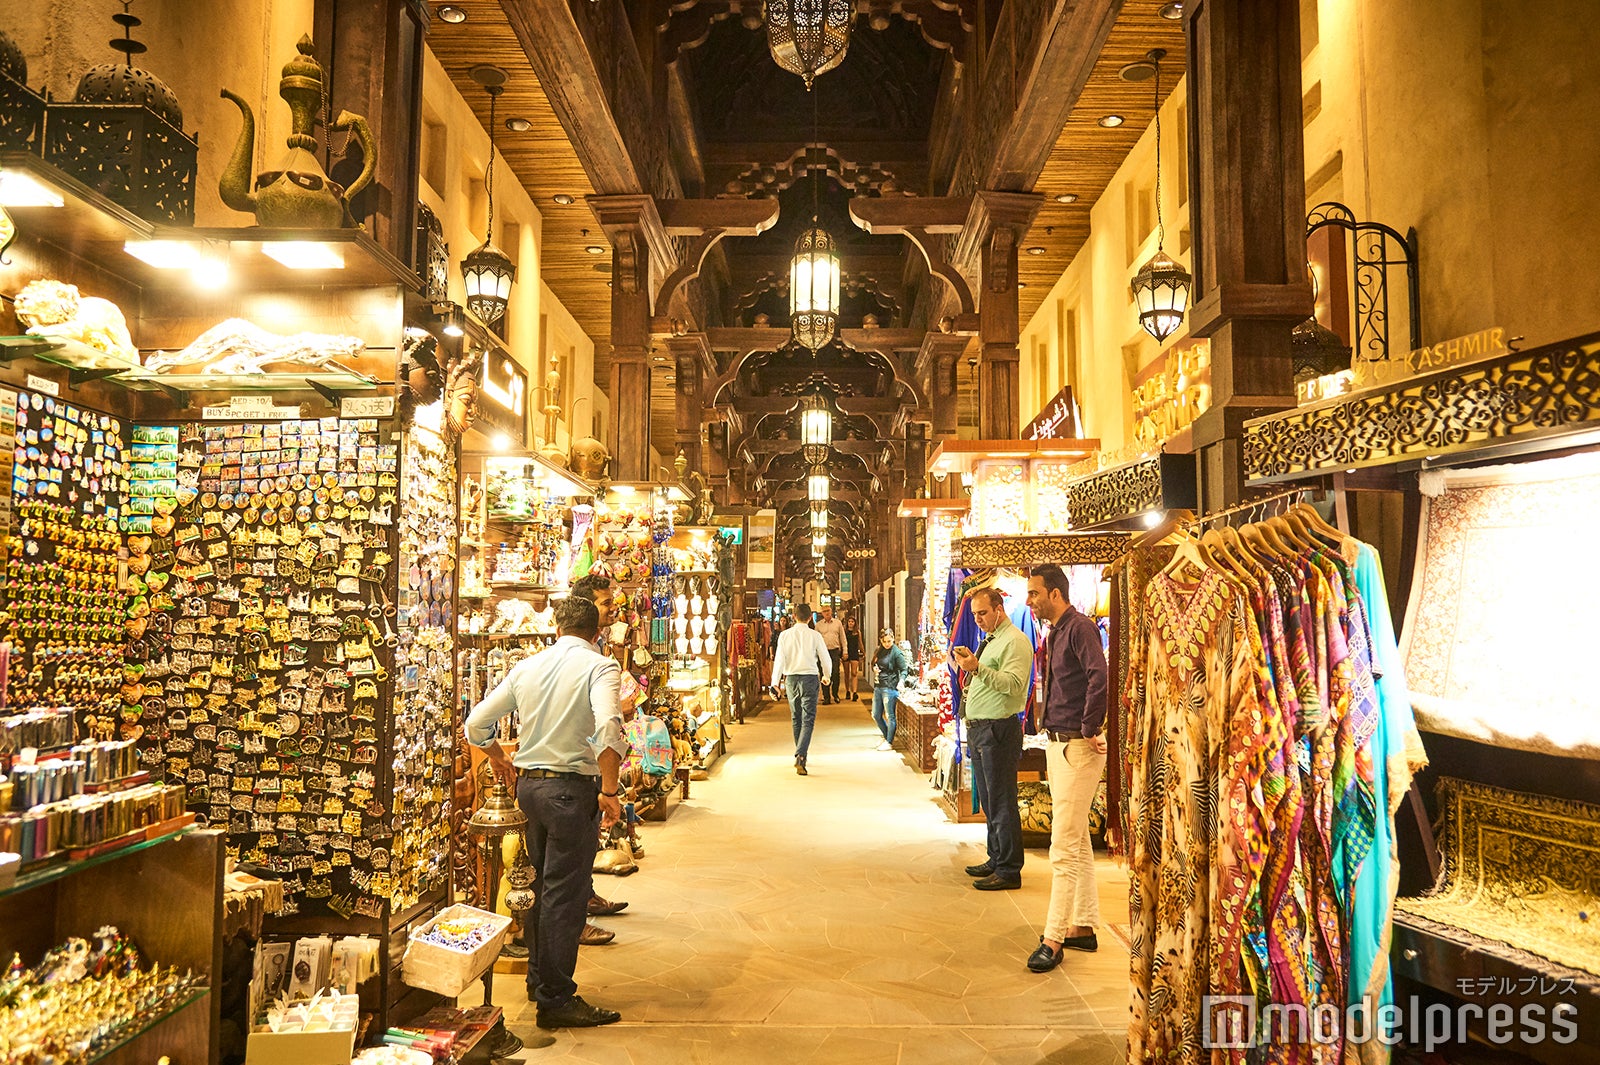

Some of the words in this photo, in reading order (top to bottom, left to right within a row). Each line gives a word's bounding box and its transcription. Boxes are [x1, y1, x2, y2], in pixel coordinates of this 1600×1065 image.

[1297, 374, 1346, 400] PRIDE
[1403, 327, 1505, 373] KASHMIR
[206, 408, 224, 417] BUY
